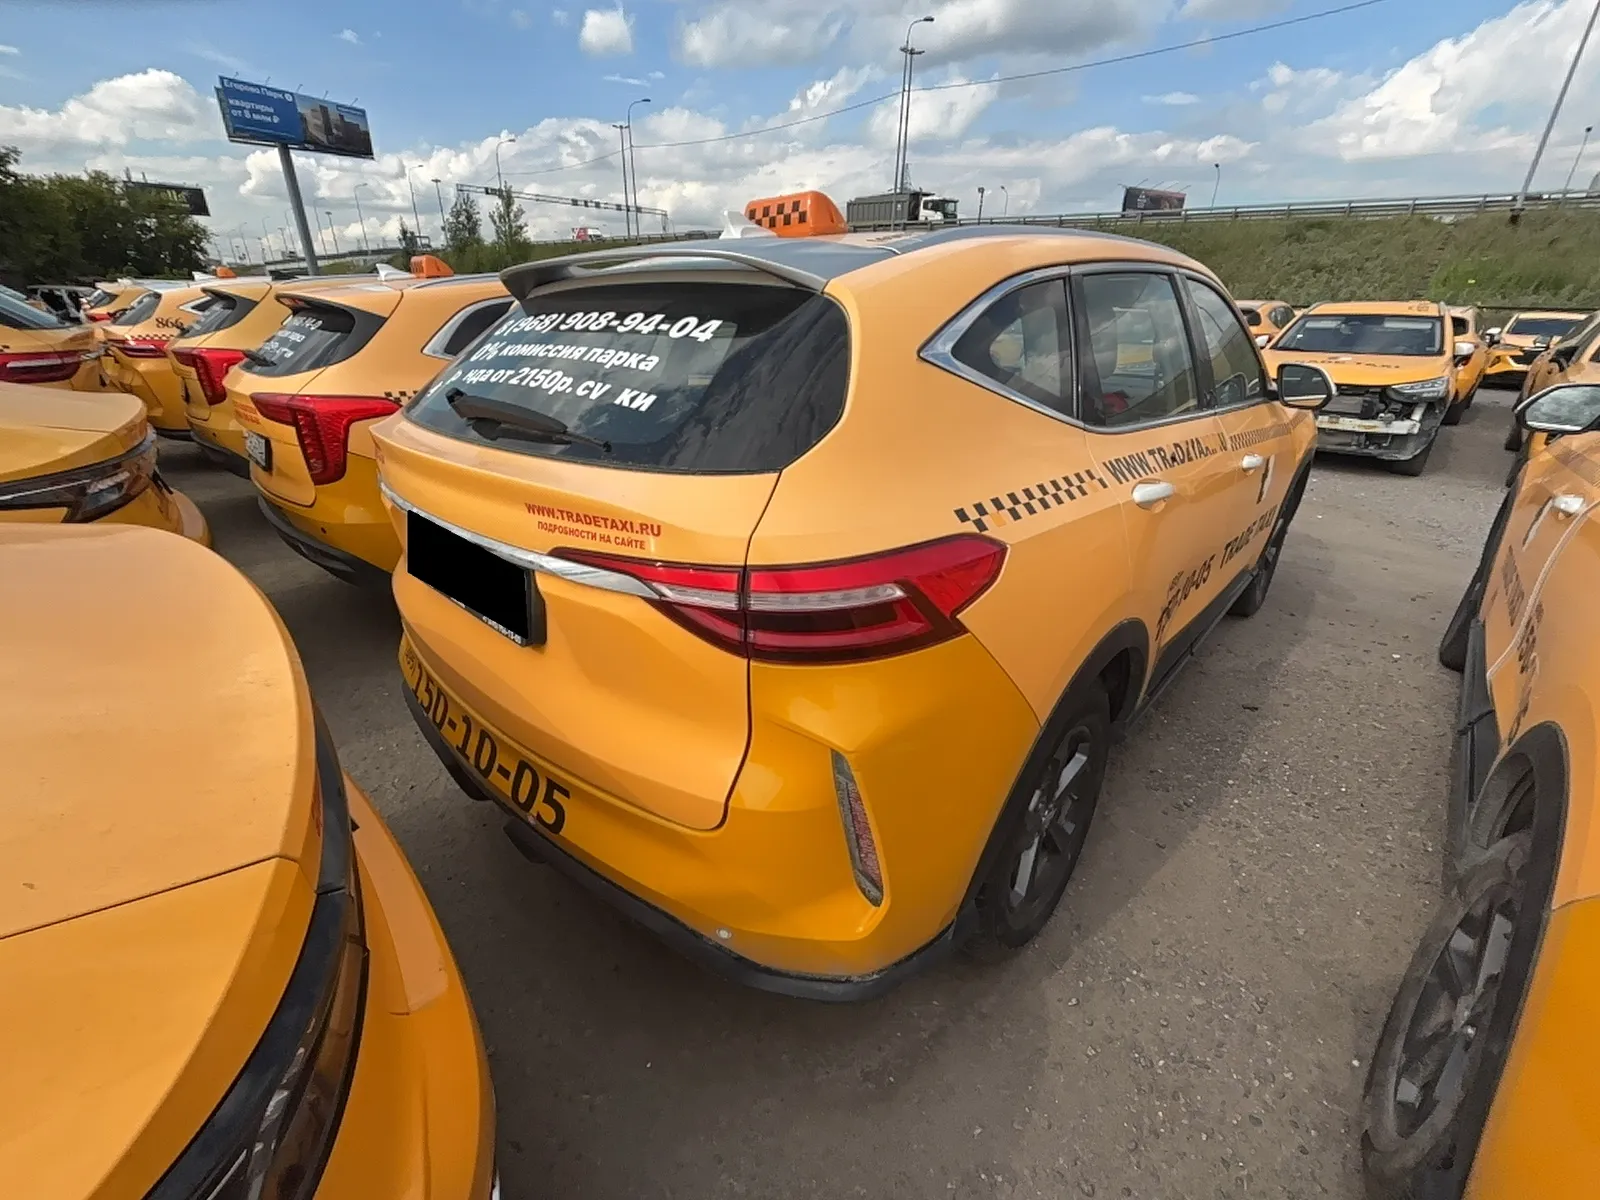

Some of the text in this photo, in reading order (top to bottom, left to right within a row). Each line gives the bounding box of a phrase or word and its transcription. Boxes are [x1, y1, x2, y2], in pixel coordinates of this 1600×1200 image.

[559, 311, 723, 342] 908-94-04
[499, 344, 586, 360] комиссия
[583, 347, 660, 371] парка
[524, 502, 662, 538] WWW.TRADETAXI.RU
[537, 520, 646, 550] ПОДРОБНОСТИ НА САЙТЕ
[411, 663, 571, 835] 150-10-05
